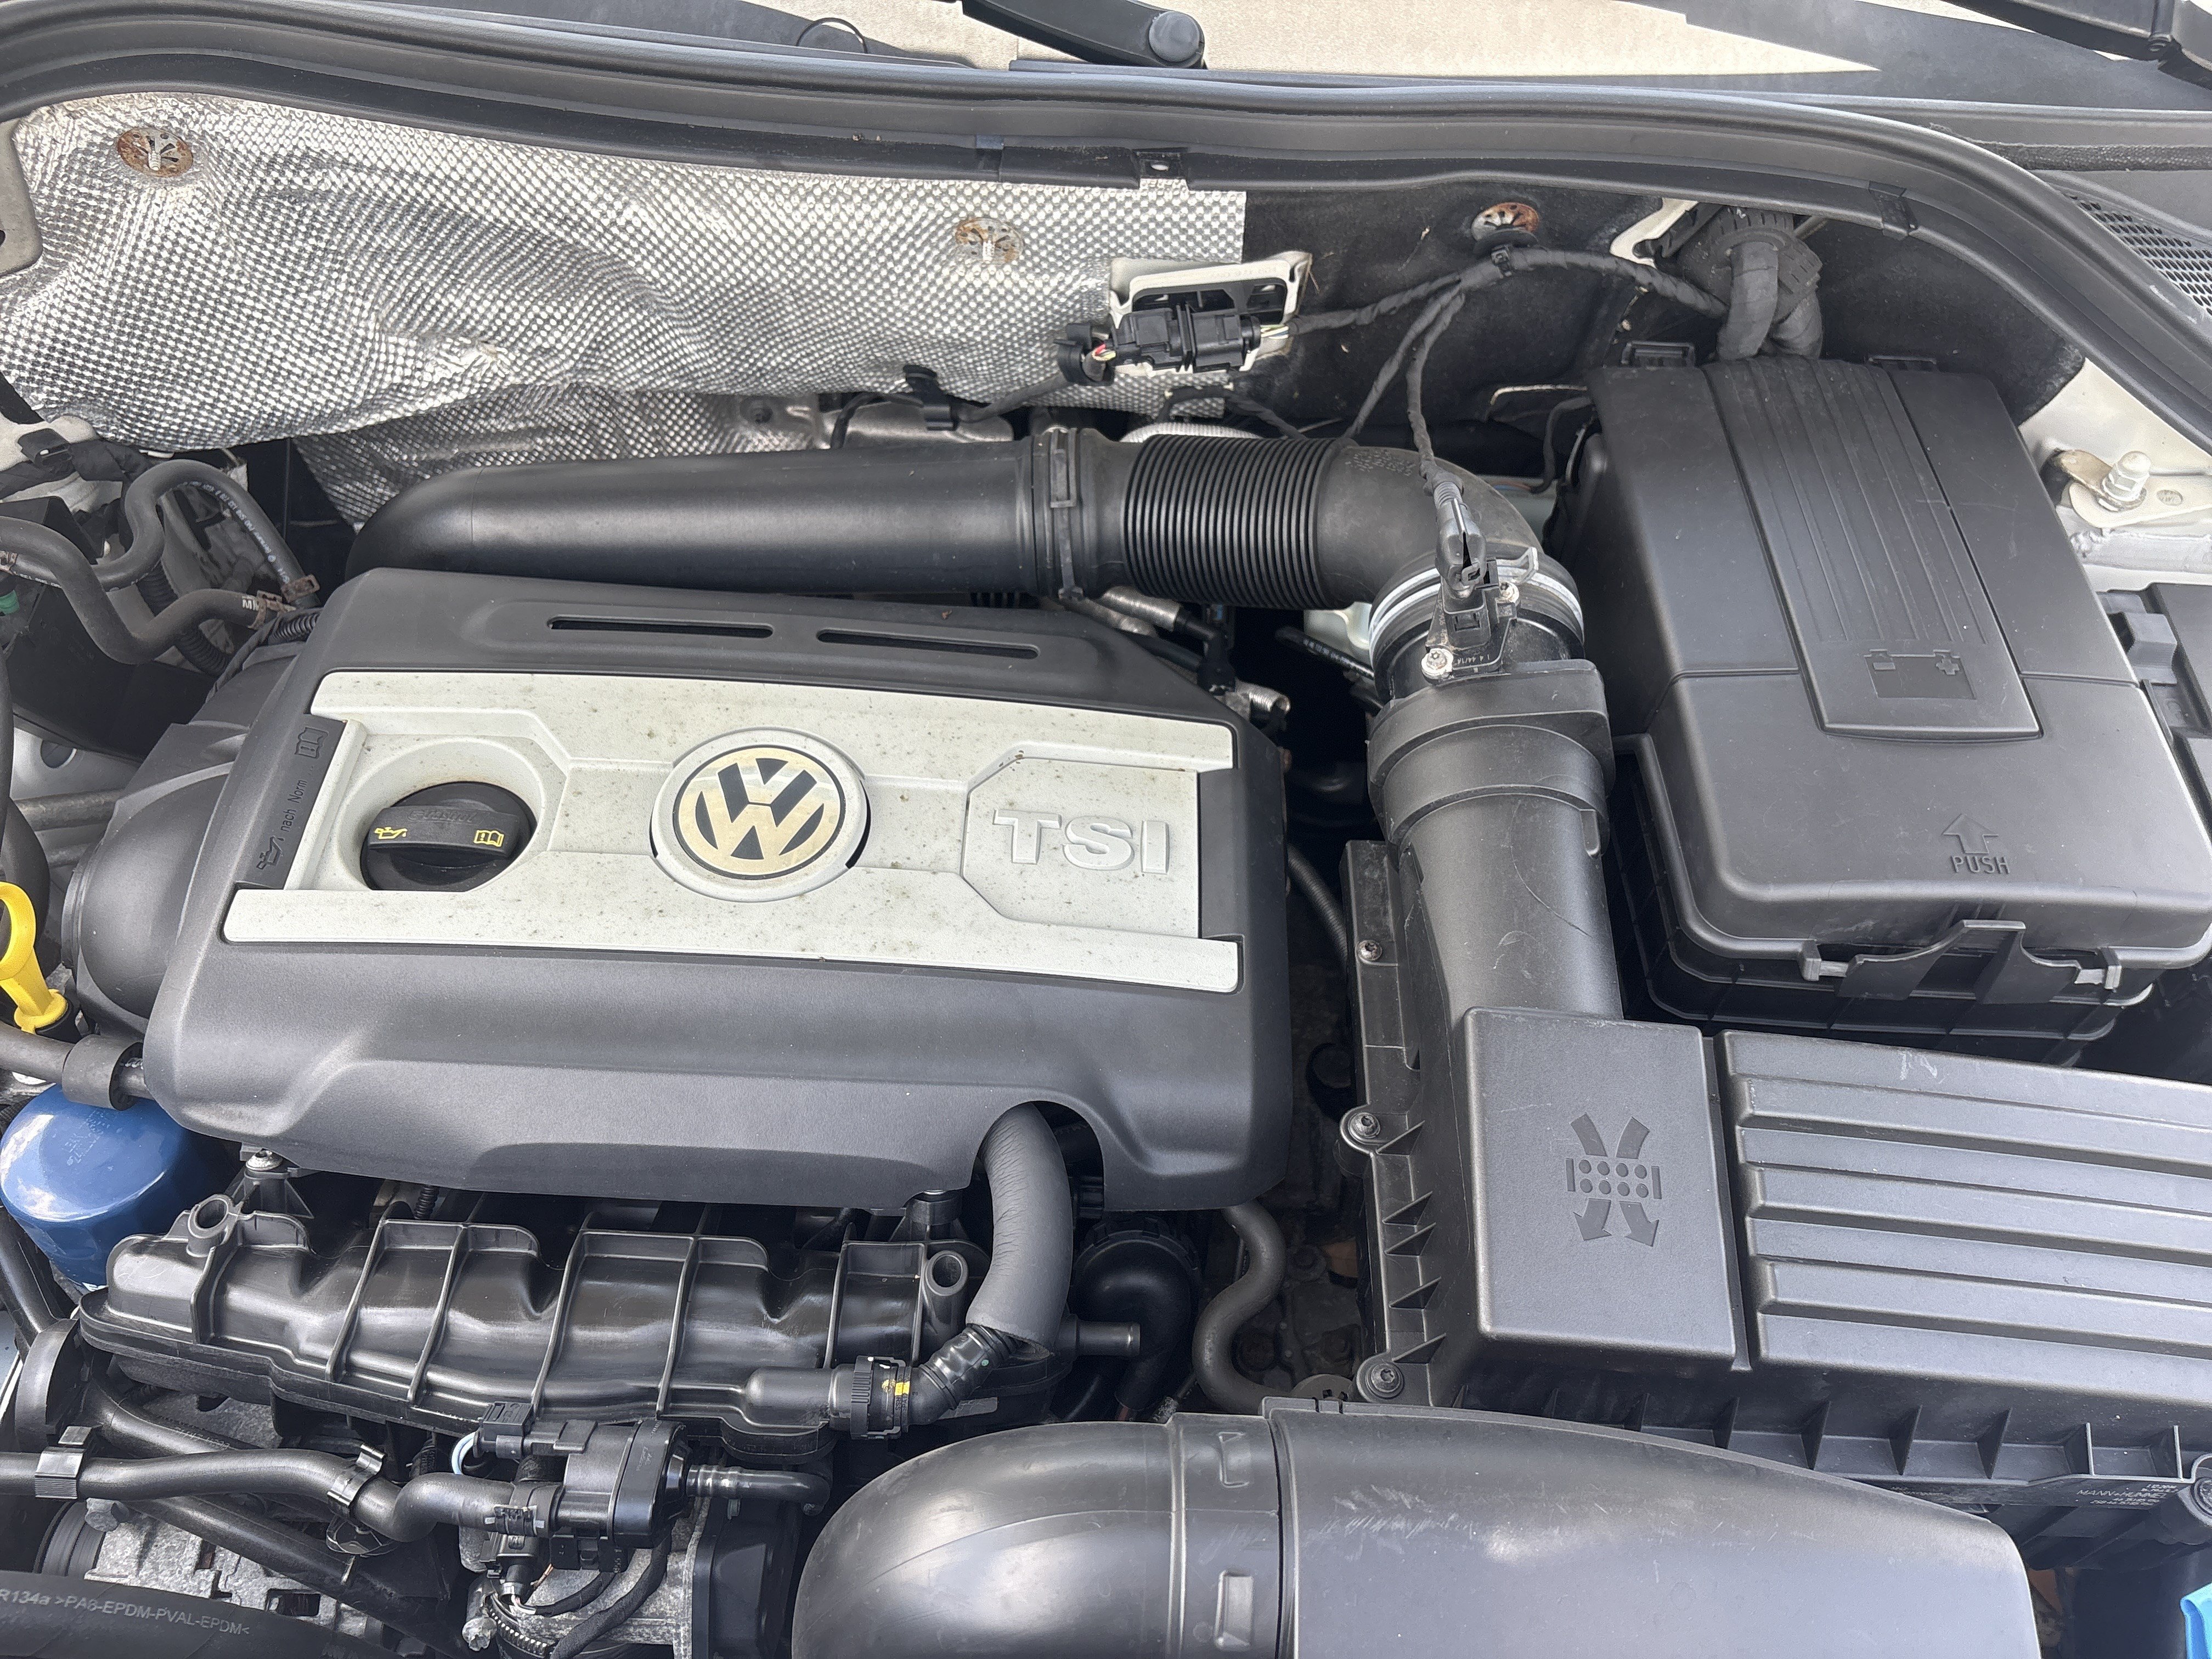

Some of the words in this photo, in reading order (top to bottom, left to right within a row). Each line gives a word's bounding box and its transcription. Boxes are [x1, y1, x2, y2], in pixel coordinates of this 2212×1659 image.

[287, 780, 307, 804] Norm
[280, 809, 297, 832] nach
[675, 746, 844, 879] VW
[992, 809, 1170, 875] TSI
[1950, 855, 2010, 874] PUSH
